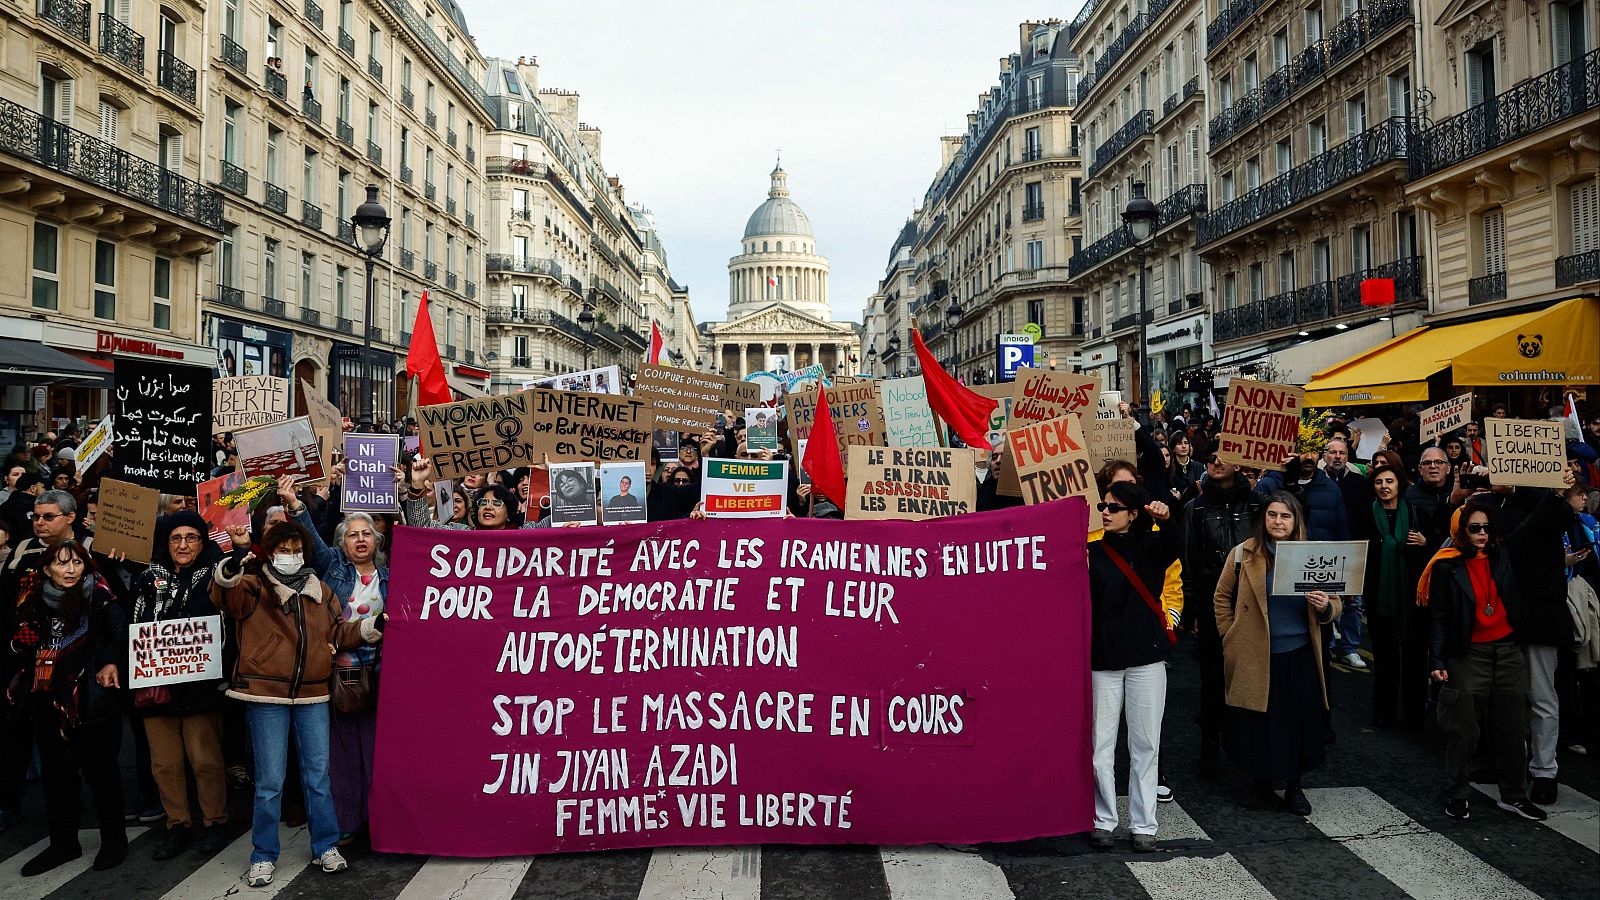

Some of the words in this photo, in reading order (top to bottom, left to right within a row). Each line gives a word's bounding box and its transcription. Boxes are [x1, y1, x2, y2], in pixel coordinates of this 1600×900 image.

[1004, 347, 1022, 370] P
[644, 368, 685, 384] COUPURE
[1499, 370, 1565, 380] columbus
[735, 385, 756, 400] AUX
[793, 394, 817, 410] ALL
[826, 387, 877, 405] OLITICAL
[1234, 385, 1285, 412] NON
[1286, 394, 1297, 409] à
[420, 394, 528, 428] WOMAN
[537, 391, 645, 422] INTERNET
[1434, 397, 1460, 413] HALTE
[1423, 403, 1464, 426] MASSACRES
[1435, 413, 1462, 433] IRAN
[1493, 424, 1560, 440] LIBERTY
[359, 443, 375, 457] Ni
[556, 442, 576, 455] en
[1009, 418, 1082, 468] FUCK
[1496, 441, 1562, 457] EQUALITY
[868, 449, 884, 466] LE
[892, 448, 952, 468] RÉGIME
[1222, 441, 1242, 454] en
[1242, 440, 1293, 465] IRAN
[124, 464, 160, 479] monde
[348, 459, 386, 473] Chah
[721, 463, 769, 476] FEMME
[1491, 458, 1562, 474] SISTERHOOD
[360, 475, 374, 489] Ni
[884, 468, 902, 482] EN
[908, 468, 951, 486] IRAN
[1020, 458, 1090, 505] TRUMP
[733, 483, 755, 493] VIE
[863, 480, 950, 500] ASSASSINE
[345, 490, 394, 505] Mollah
[715, 496, 772, 509] LIBERTÉ
[860, 496, 887, 512] LES
[897, 497, 968, 517] ENFANTS
[429, 538, 615, 578] SOLIDARITÉ
[629, 538, 700, 572] AVEC
[718, 537, 764, 568] LES
[780, 538, 928, 578] IRANIEN.NES
[942, 545, 969, 576] EN
[975, 535, 1047, 573] LUTTE
[1303, 555, 1338, 570] ایران
[420, 585, 494, 620] POUR
[513, 585, 551, 618] LA
[578, 577, 740, 616] DEMOCRATIE
[766, 576, 805, 612] ET
[825, 580, 900, 624] LEUR
[160, 620, 208, 637] CHAH
[153, 633, 214, 650] MOLLAH
[495, 624, 798, 675] AUTODÉTERMINATION
[156, 645, 204, 658] TRUMP
[140, 658, 157, 669] LE
[154, 662, 206, 678] PEUPLE
[491, 694, 575, 736] STOP
[593, 695, 628, 734] LE
[640, 690, 814, 733] MASSACRE
[830, 695, 870, 737] EN
[888, 693, 965, 735] COURS
[482, 753, 541, 795] JIN
[548, 748, 629, 793] JIYAN
[643, 742, 738, 788] AZADI
[676, 793, 726, 828] VIE
[739, 789, 853, 829] LIBERTÉ
